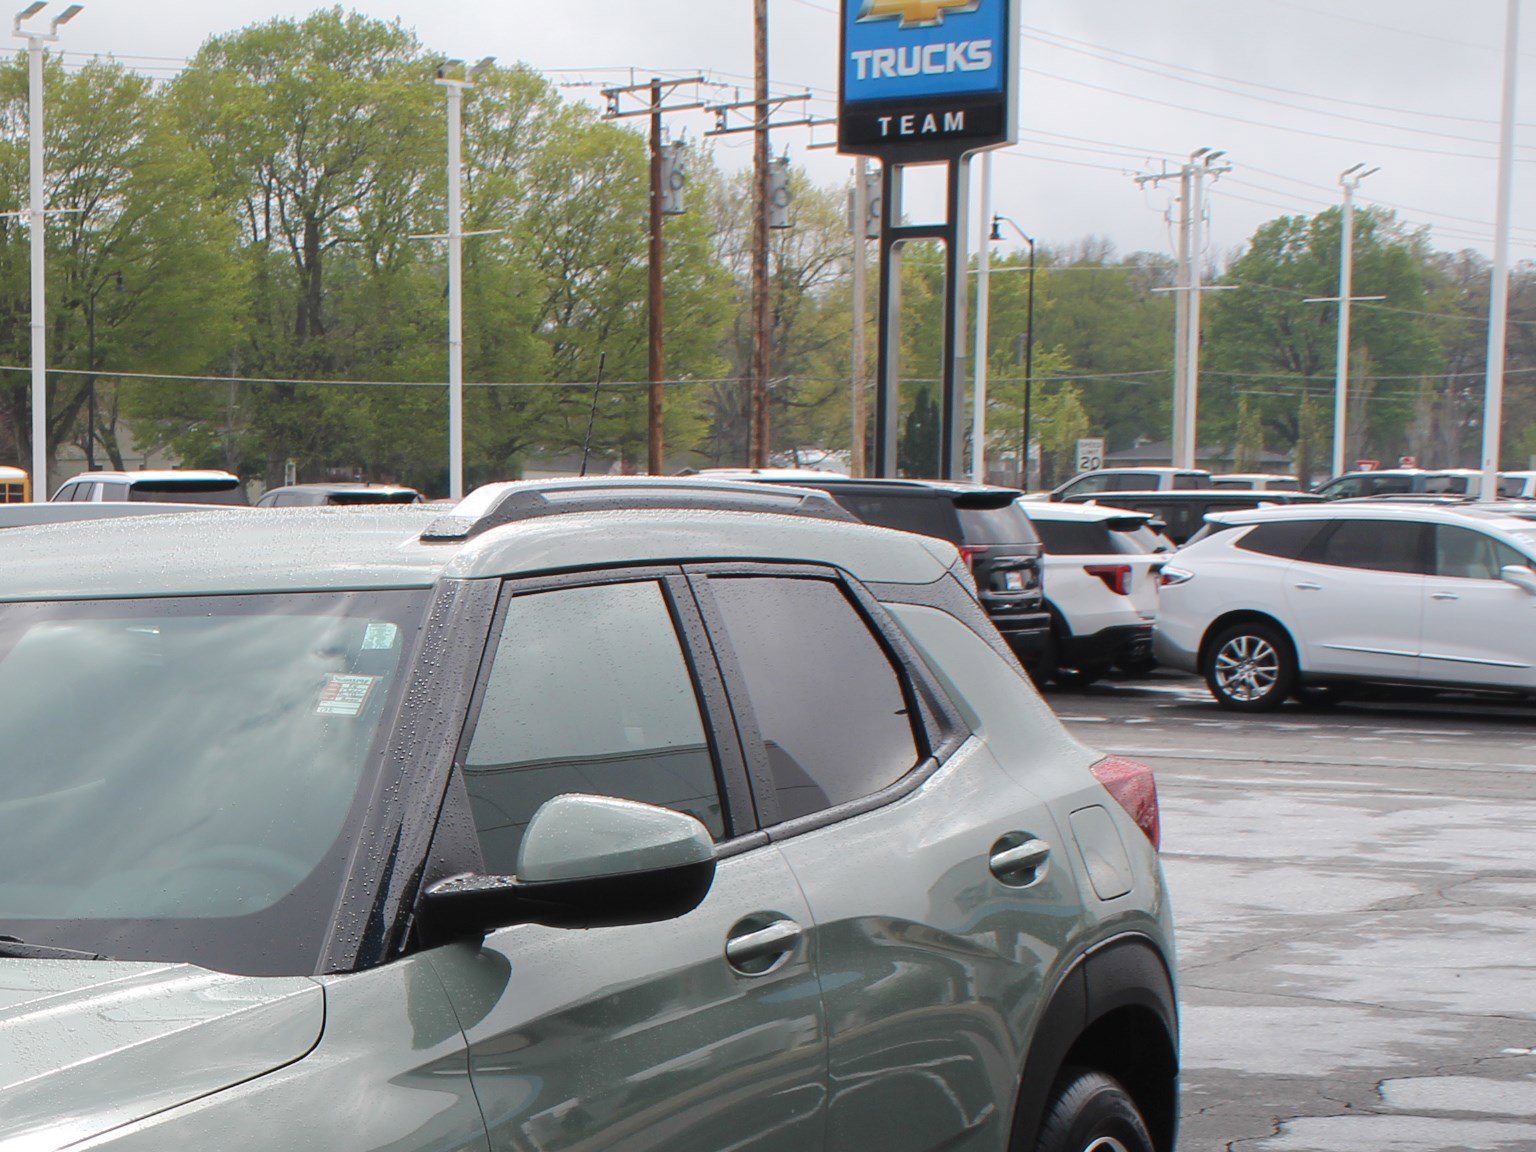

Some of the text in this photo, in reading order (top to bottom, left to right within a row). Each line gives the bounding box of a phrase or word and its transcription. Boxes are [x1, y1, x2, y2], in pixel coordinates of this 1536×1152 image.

[851, 39, 993, 81] TRUCKS
[878, 110, 965, 137] TEAM
[1079, 456, 1101, 471] 20
